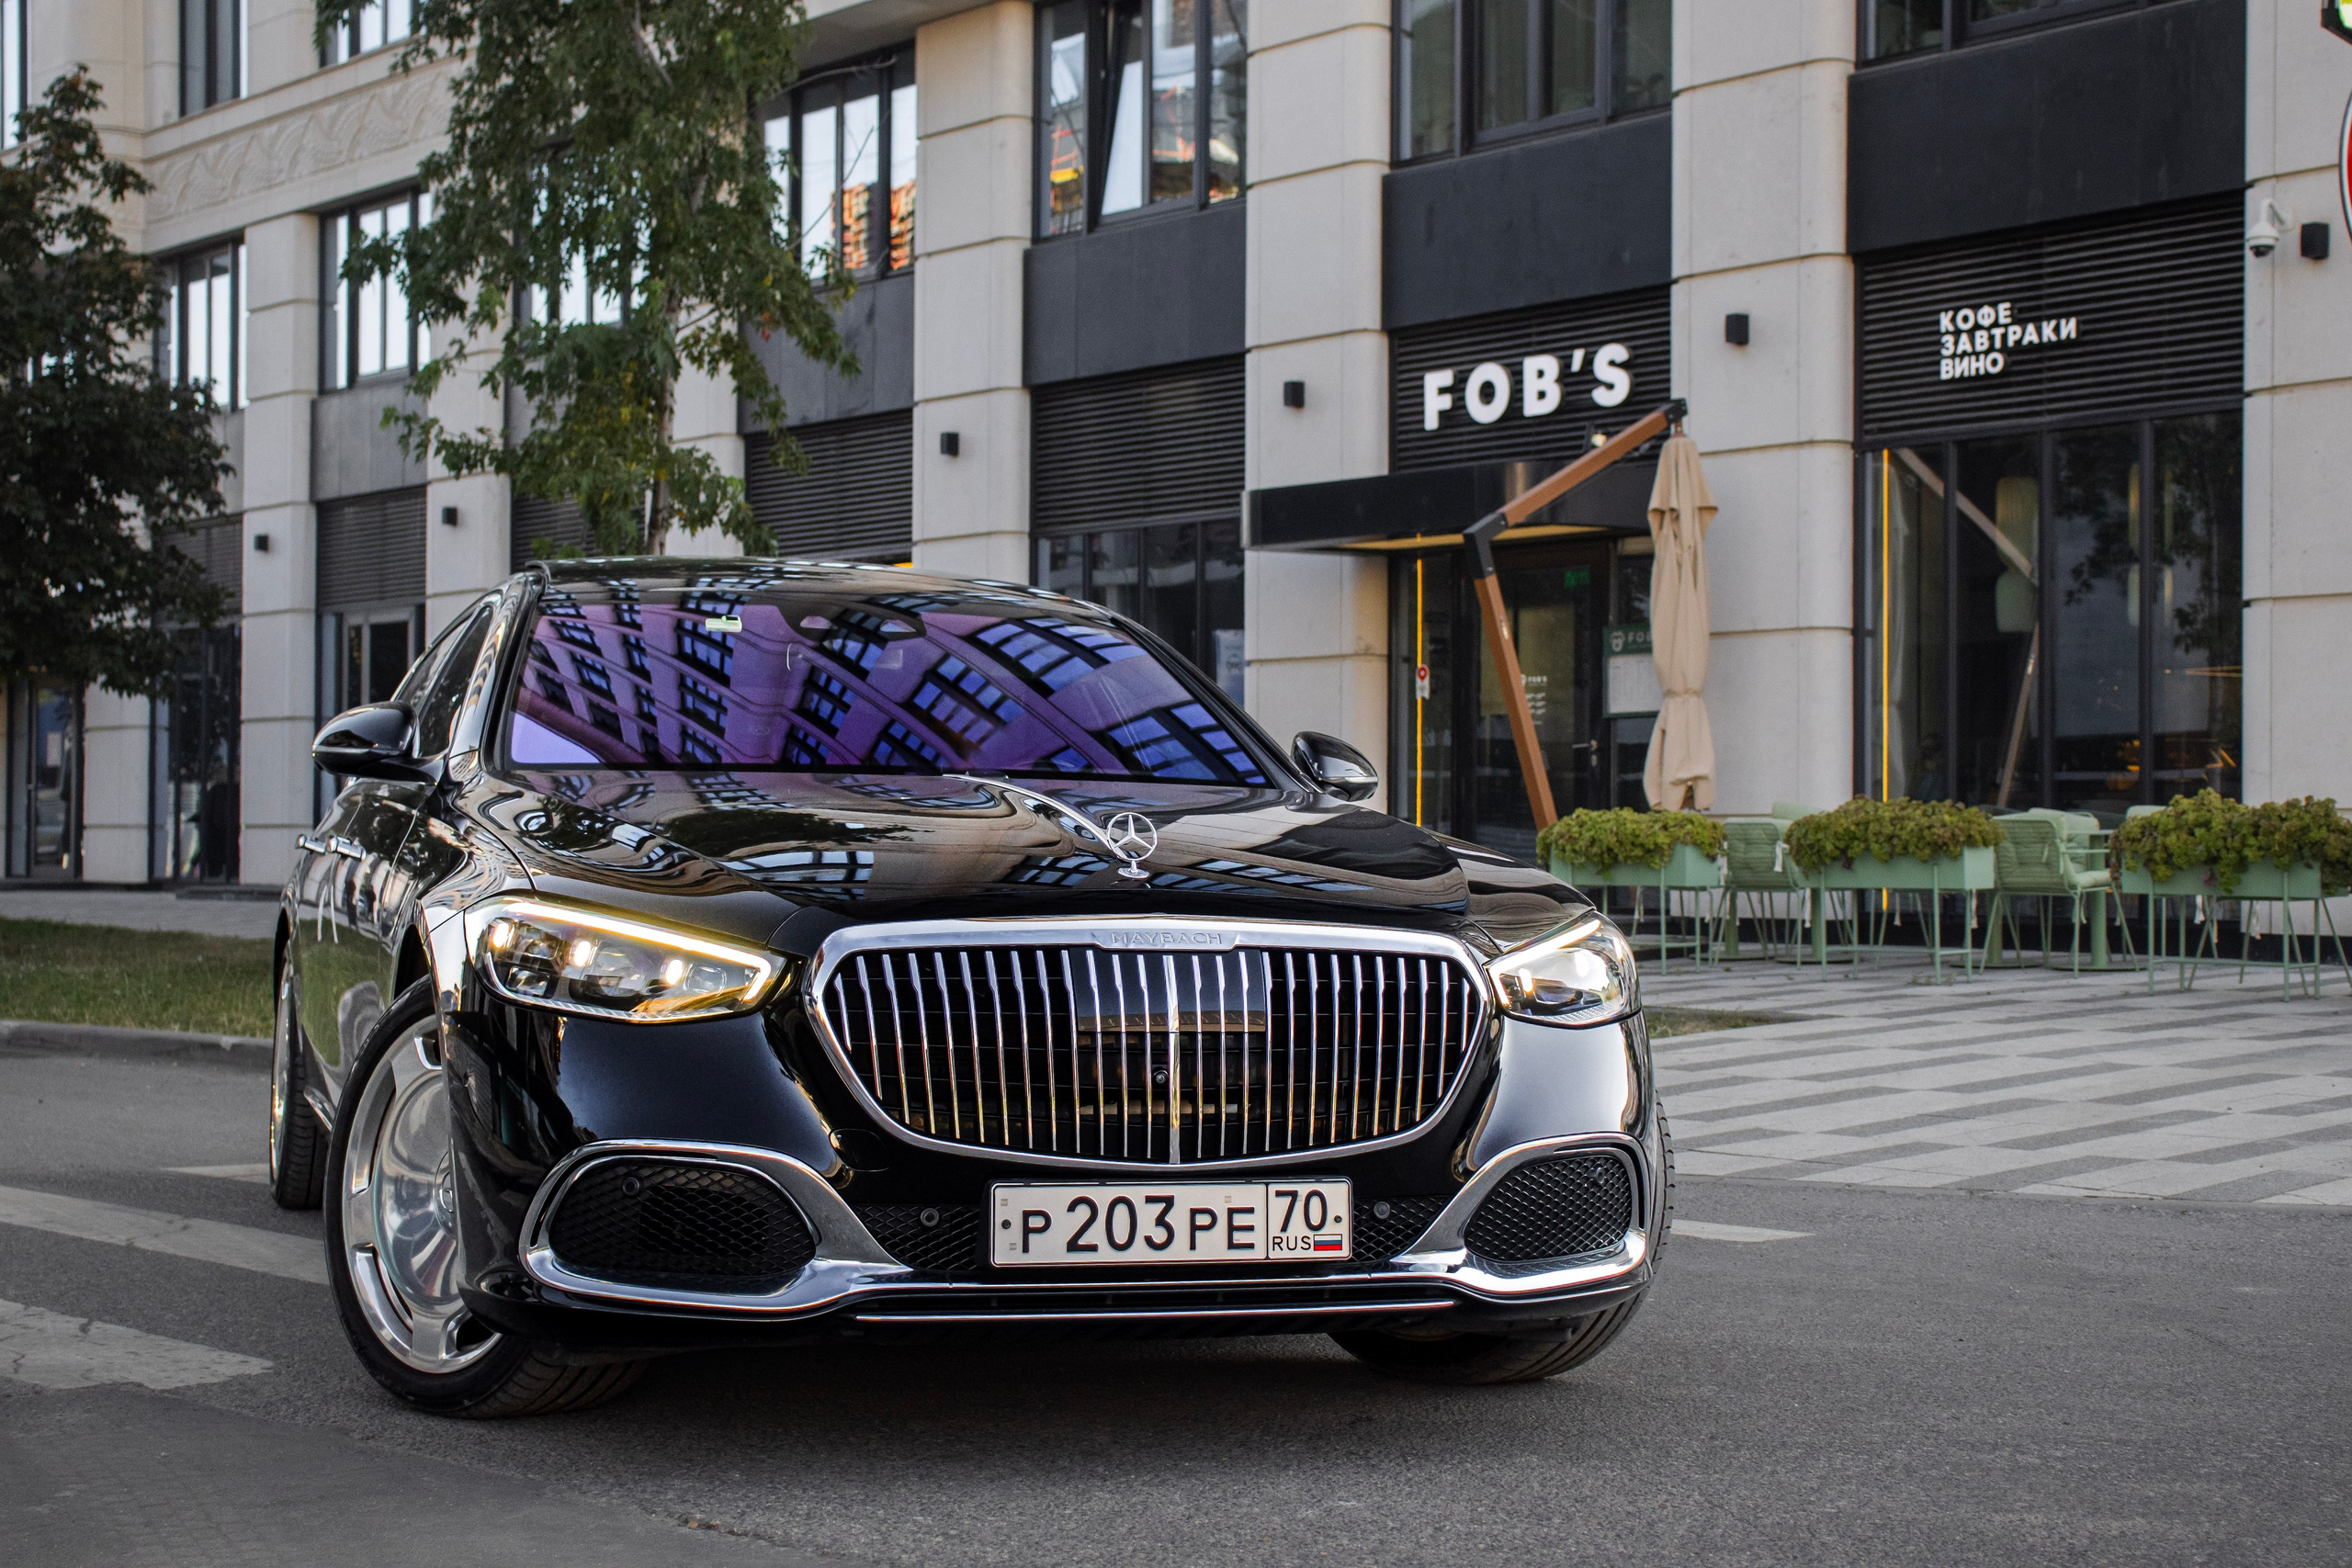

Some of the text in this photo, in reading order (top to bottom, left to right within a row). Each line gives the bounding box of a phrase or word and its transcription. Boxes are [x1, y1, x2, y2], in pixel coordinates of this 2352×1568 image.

[1939, 301, 2013, 333] КОФЕ
[1939, 316, 2078, 356] ЗАВТРАКИ
[1939, 351, 2006, 380] ВИНО
[1423, 343, 1634, 431] FOB'S
[1111, 931, 1222, 945] MAYBACH
[1275, 1189, 1328, 1233] 70
[1272, 1235, 1312, 1251] RUS
